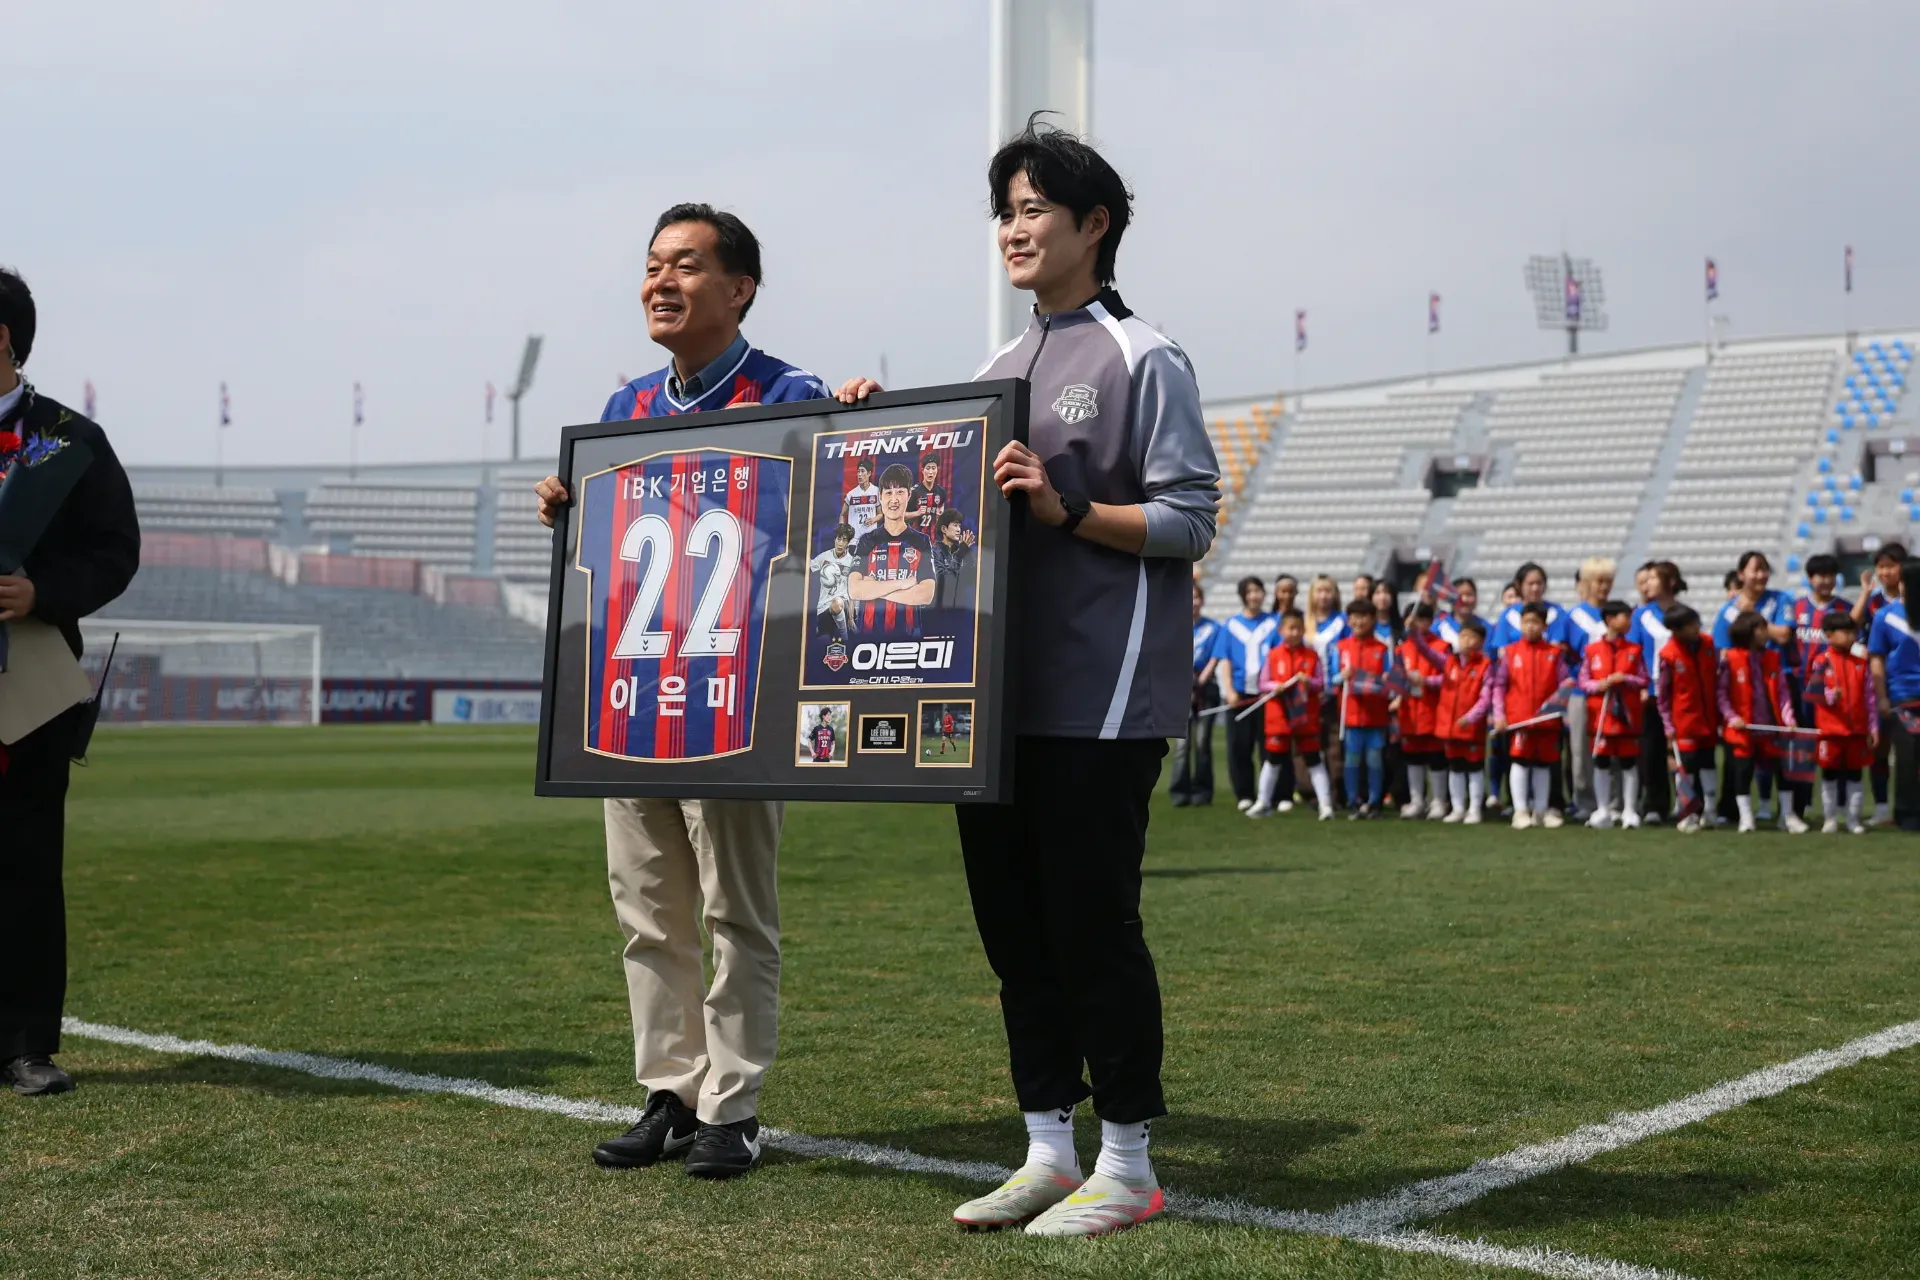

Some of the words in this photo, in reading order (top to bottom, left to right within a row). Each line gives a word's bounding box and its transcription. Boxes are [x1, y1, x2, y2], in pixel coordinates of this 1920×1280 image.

[824, 436, 913, 459] THANK
[916, 430, 974, 450] YOU
[920, 514, 932, 526] 22
[611, 508, 743, 659] 22
[852, 641, 955, 670] 이은미
